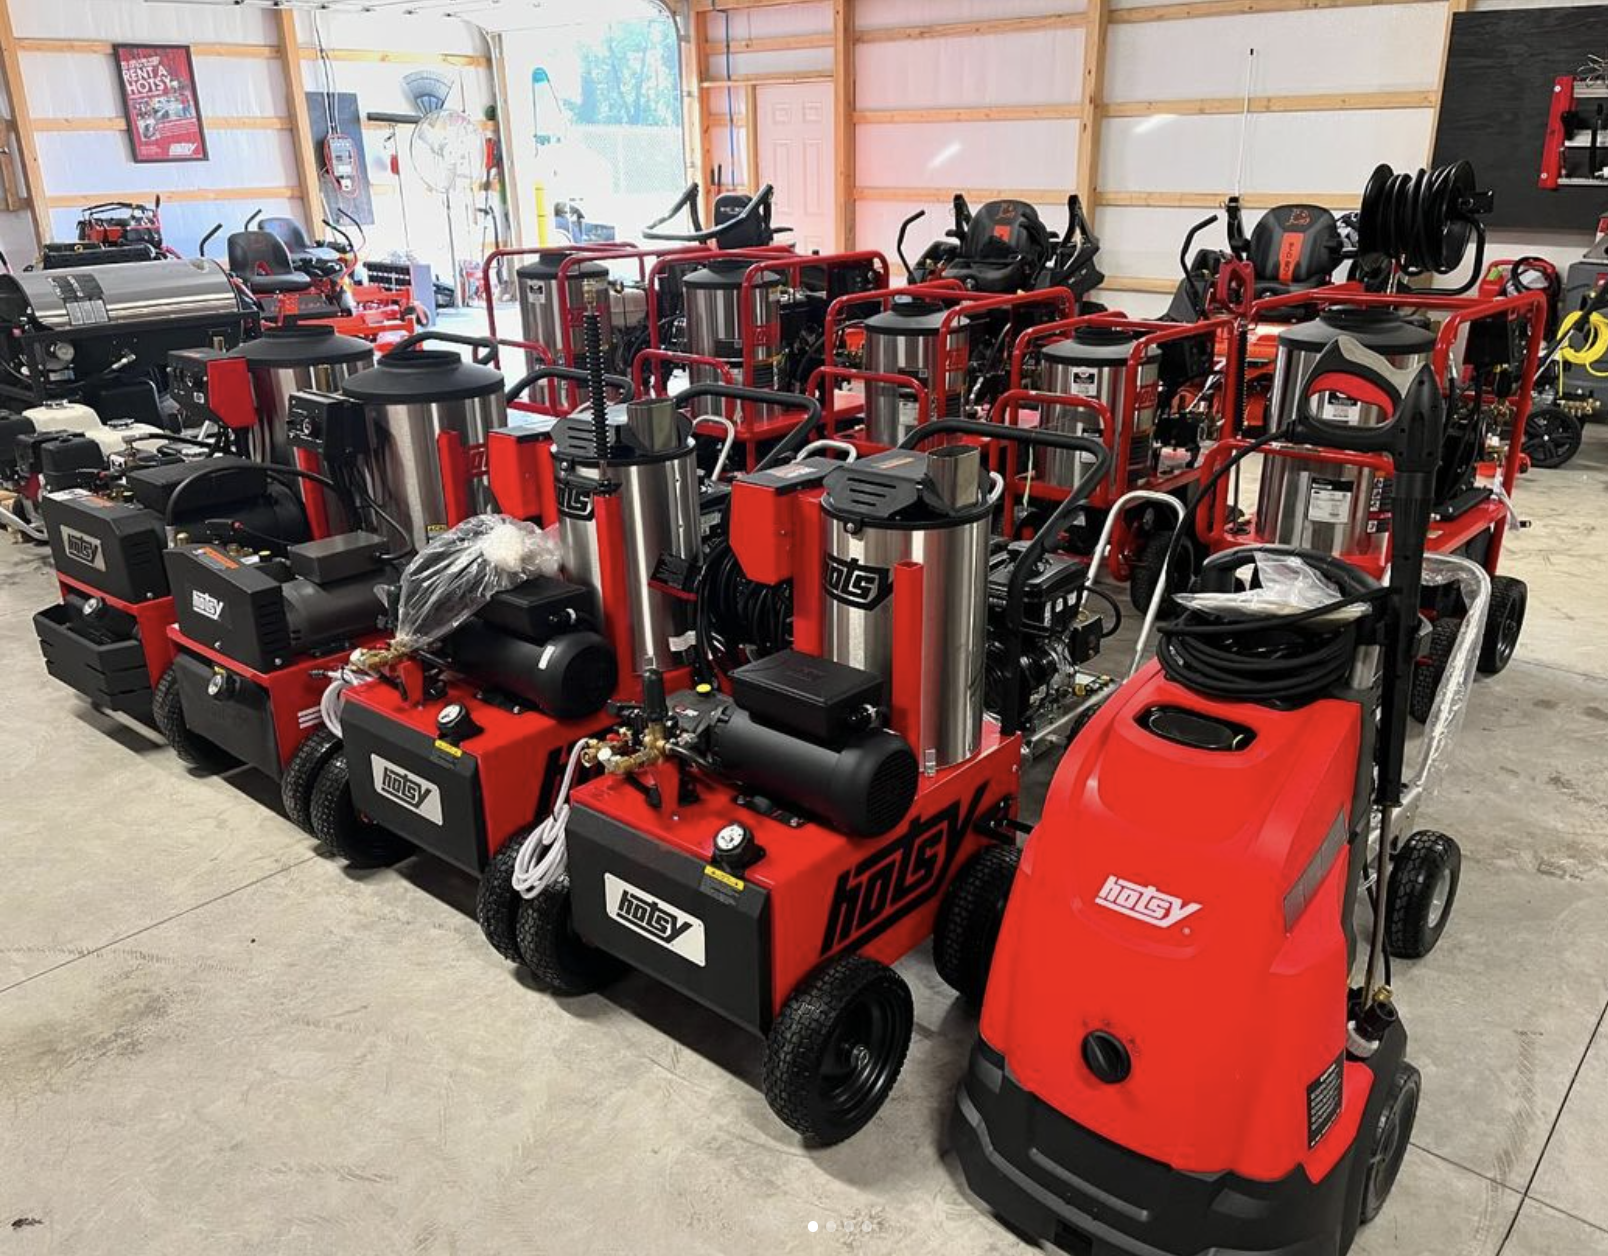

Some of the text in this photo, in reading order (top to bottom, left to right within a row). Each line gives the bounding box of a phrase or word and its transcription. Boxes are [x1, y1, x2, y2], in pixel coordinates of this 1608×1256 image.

[122, 65, 168, 81] RENT A
[125, 75, 171, 95] HOTSY
[381, 765, 433, 809] hotsy
[820, 780, 991, 958] hotsy
[615, 888, 694, 944] hotsy
[1094, 874, 1203, 929] hotsy
